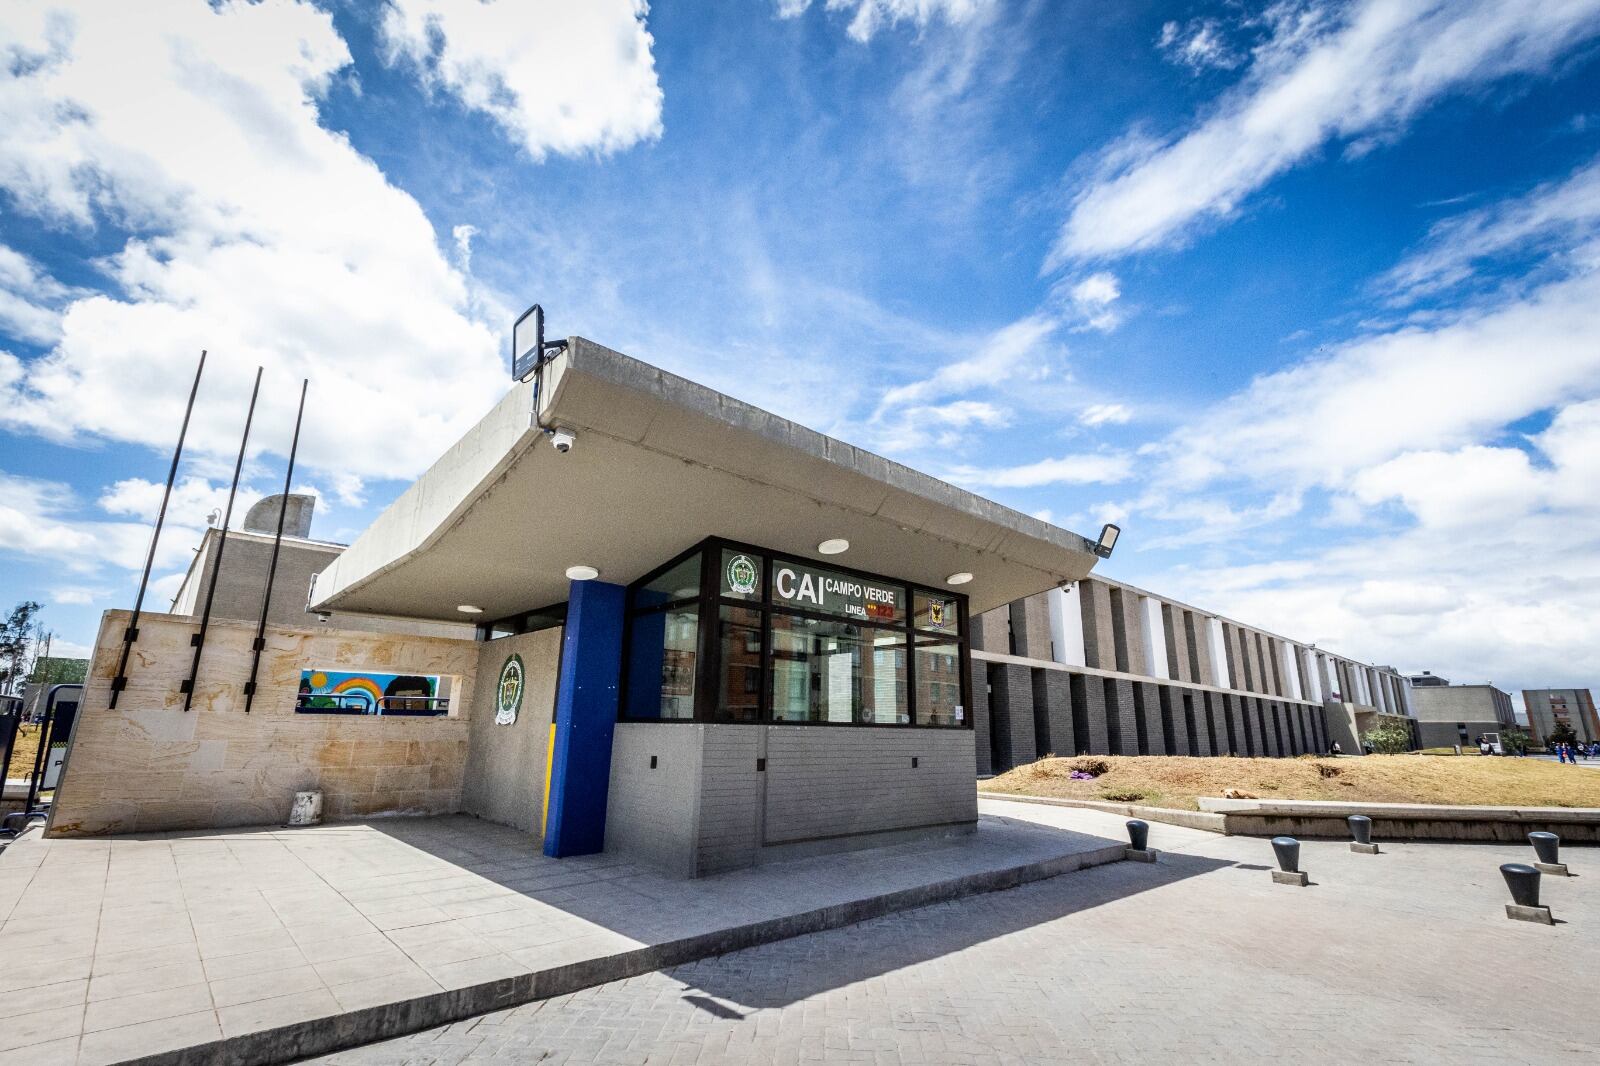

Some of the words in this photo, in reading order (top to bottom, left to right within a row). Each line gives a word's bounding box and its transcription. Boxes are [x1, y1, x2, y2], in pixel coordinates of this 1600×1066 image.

[776, 568, 824, 605] CAI
[825, 578, 862, 598] CAMPO
[863, 586, 895, 605] VERDE
[845, 603, 867, 616] LINEA
